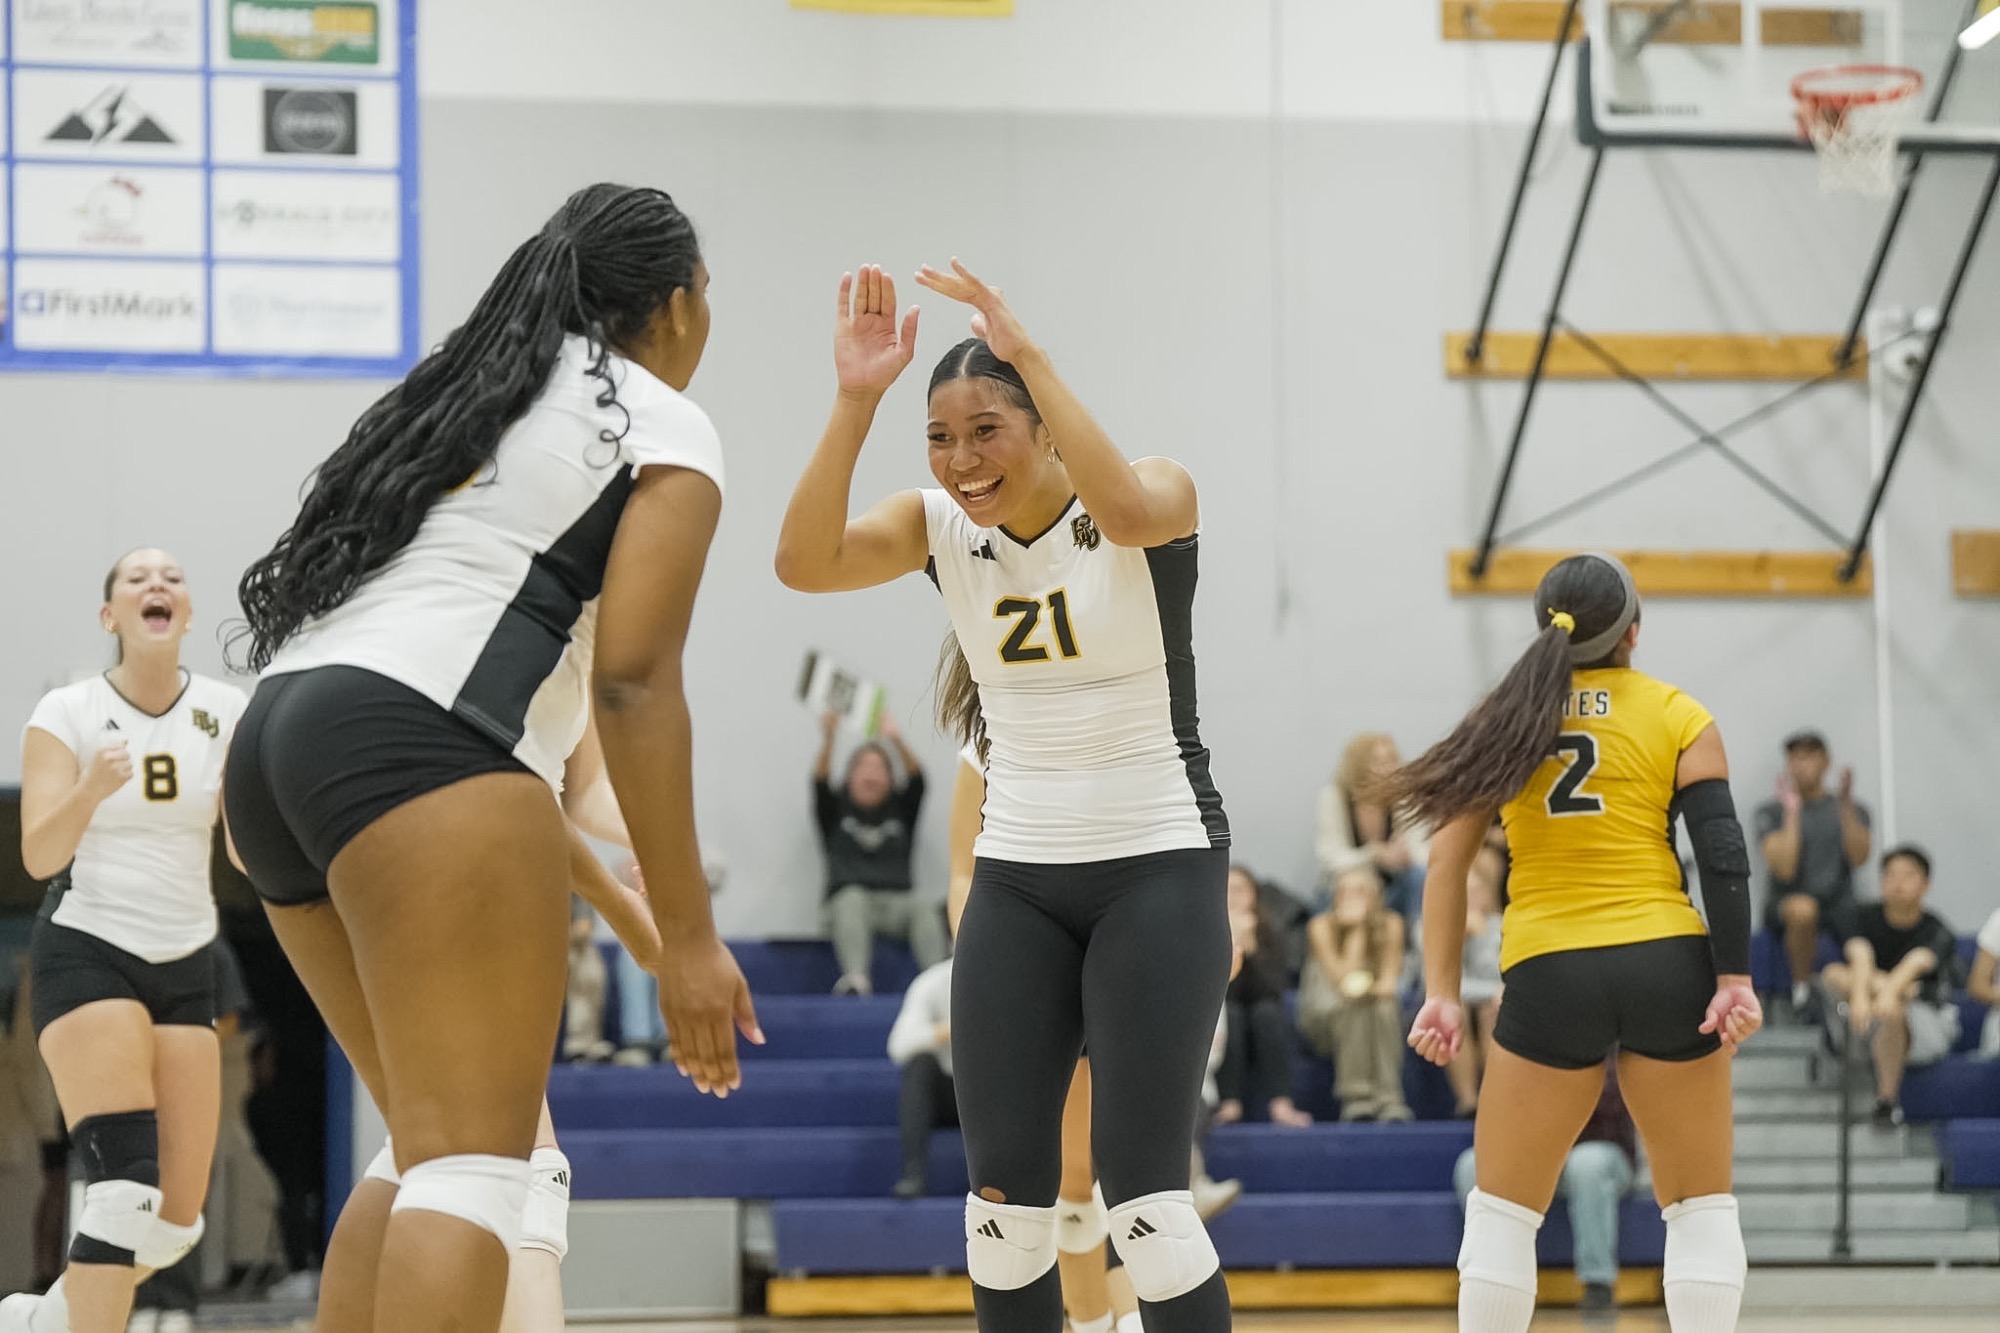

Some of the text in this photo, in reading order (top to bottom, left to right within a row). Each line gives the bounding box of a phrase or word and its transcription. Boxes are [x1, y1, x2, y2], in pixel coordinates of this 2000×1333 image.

[991, 586, 1082, 666] 21
[143, 752, 180, 803] 8
[1544, 730, 1605, 818] 2
